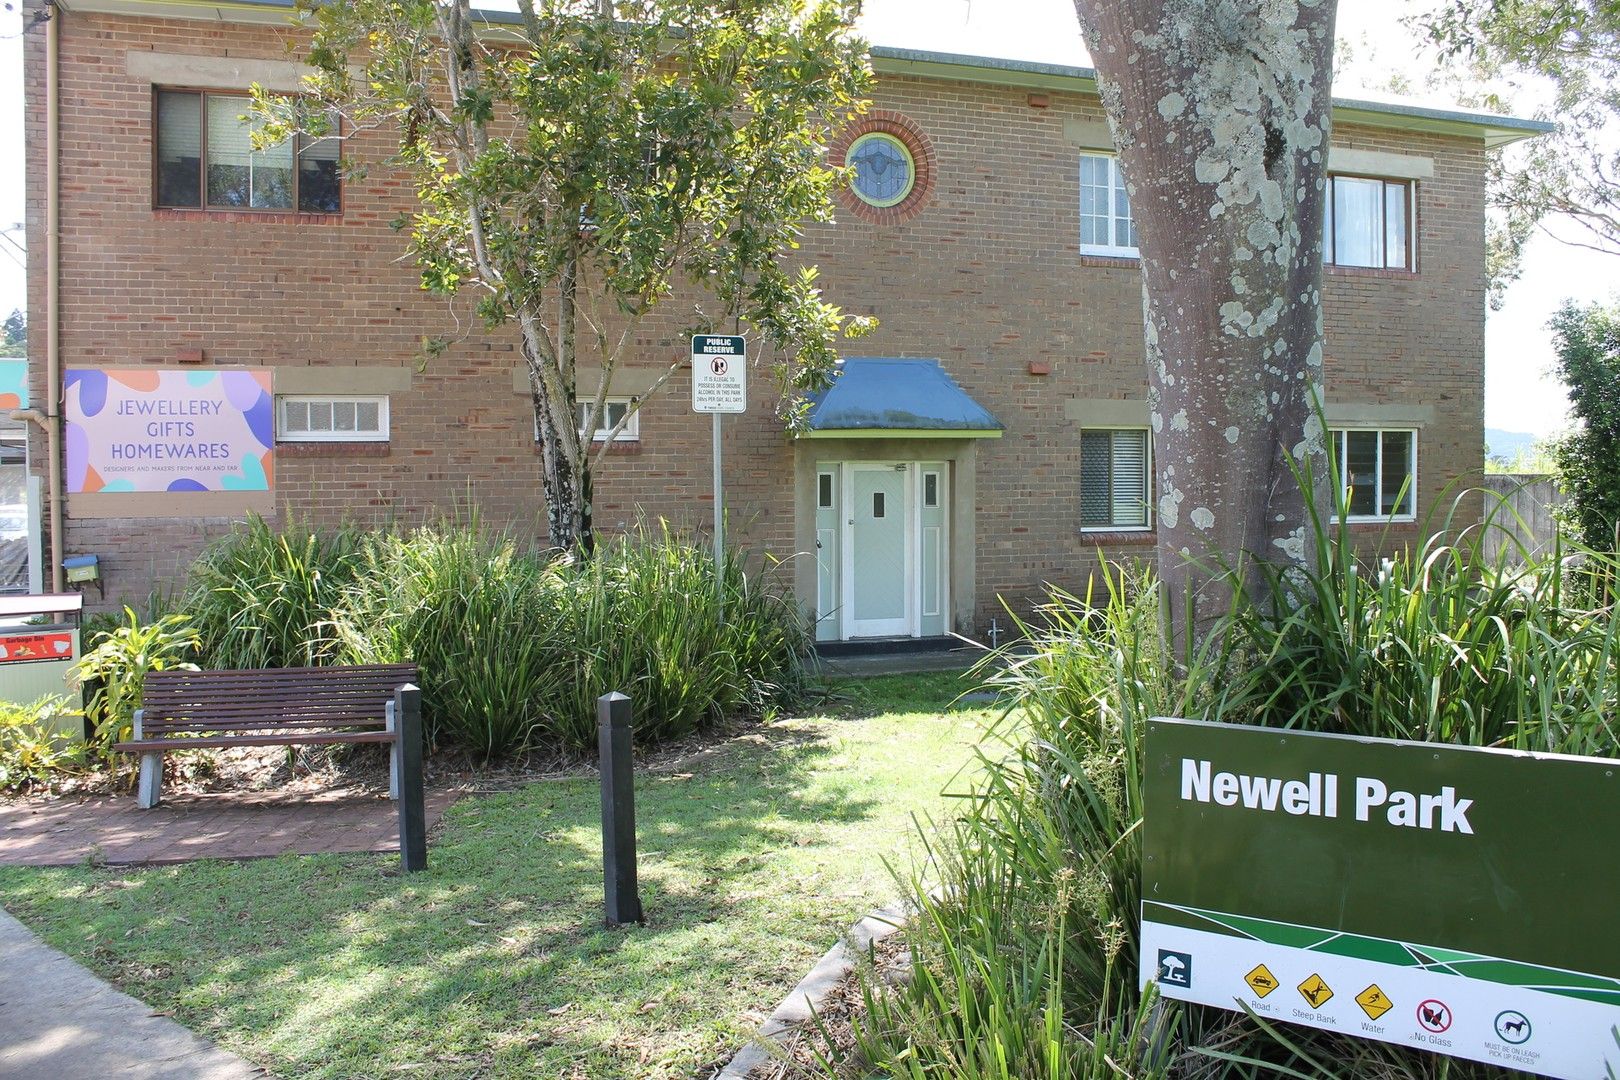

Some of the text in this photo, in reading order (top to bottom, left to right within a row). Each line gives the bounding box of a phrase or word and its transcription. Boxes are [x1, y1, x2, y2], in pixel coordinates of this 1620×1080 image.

[703, 346, 735, 354] RESERVE
[116, 400, 223, 416] JEWELLERY
[147, 421, 195, 437] GIFTS
[111, 443, 230, 460] HOMEWARES
[1181, 758, 1474, 835] Newell Park
[1251, 1000, 1271, 1012] Road
[1292, 1009, 1336, 1025] Steep Bank
[1361, 1022, 1385, 1034] Water
[1414, 1032, 1452, 1048] No Glass
[1484, 1042, 1500, 1050] MUST
[1511, 1047, 1520, 1055] ON
[1521, 1049, 1540, 1058] LEASH
[1488, 1050, 1502, 1058] PICK
[1512, 1054, 1535, 1064] FAECES
